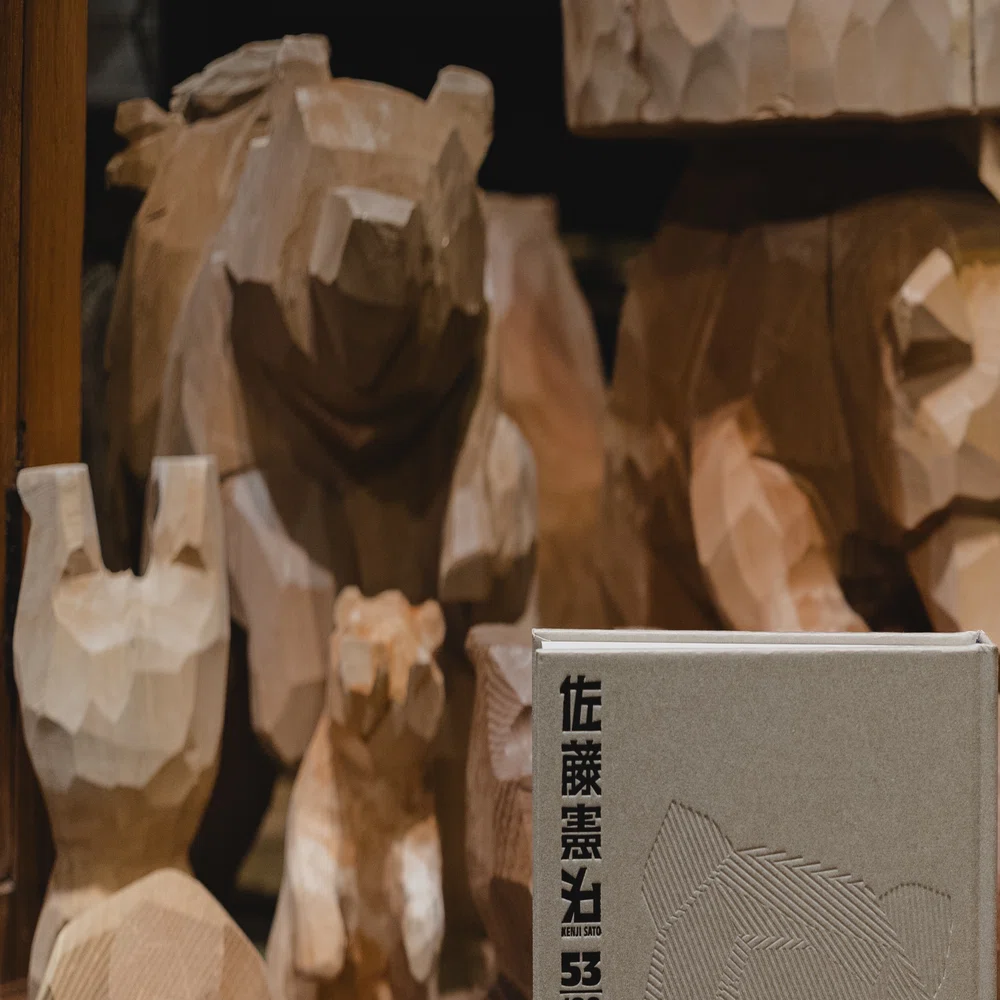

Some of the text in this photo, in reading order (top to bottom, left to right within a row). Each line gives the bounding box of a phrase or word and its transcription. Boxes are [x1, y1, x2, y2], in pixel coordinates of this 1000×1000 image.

[561, 926, 602, 938] KENJI SATO
[561, 951, 601, 986] 53
